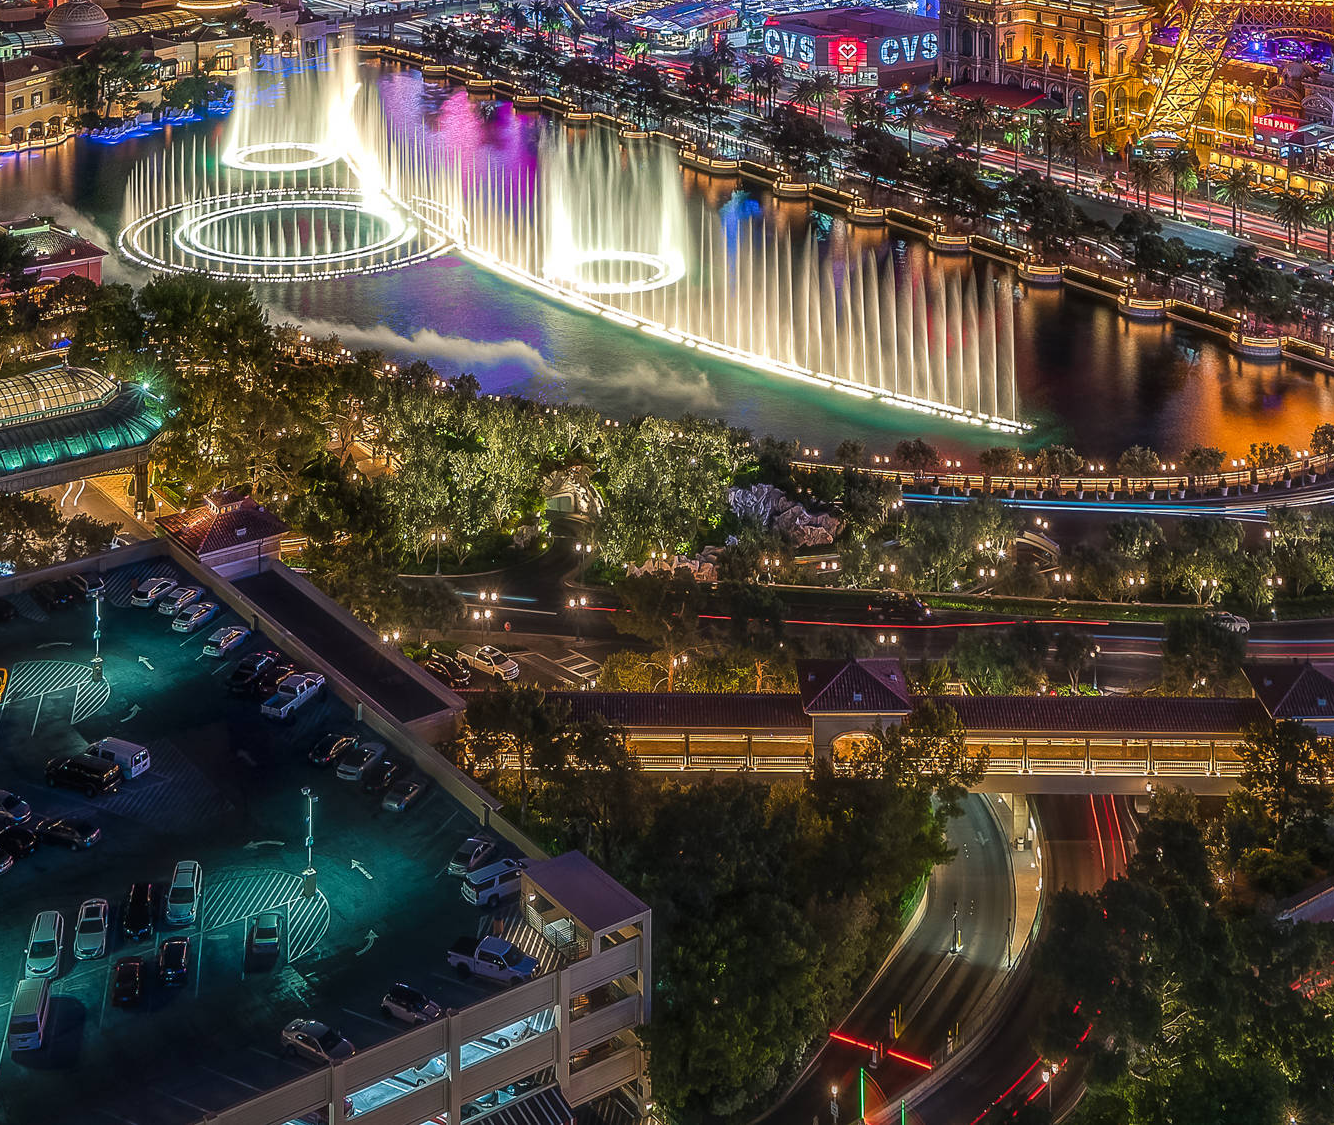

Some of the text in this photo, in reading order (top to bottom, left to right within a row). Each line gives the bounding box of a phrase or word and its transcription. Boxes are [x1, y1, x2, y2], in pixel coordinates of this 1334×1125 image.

[764, 29, 815, 62] CVS
[880, 33, 940, 65] CVS
[1253, 116, 1295, 131] BEER PARK
